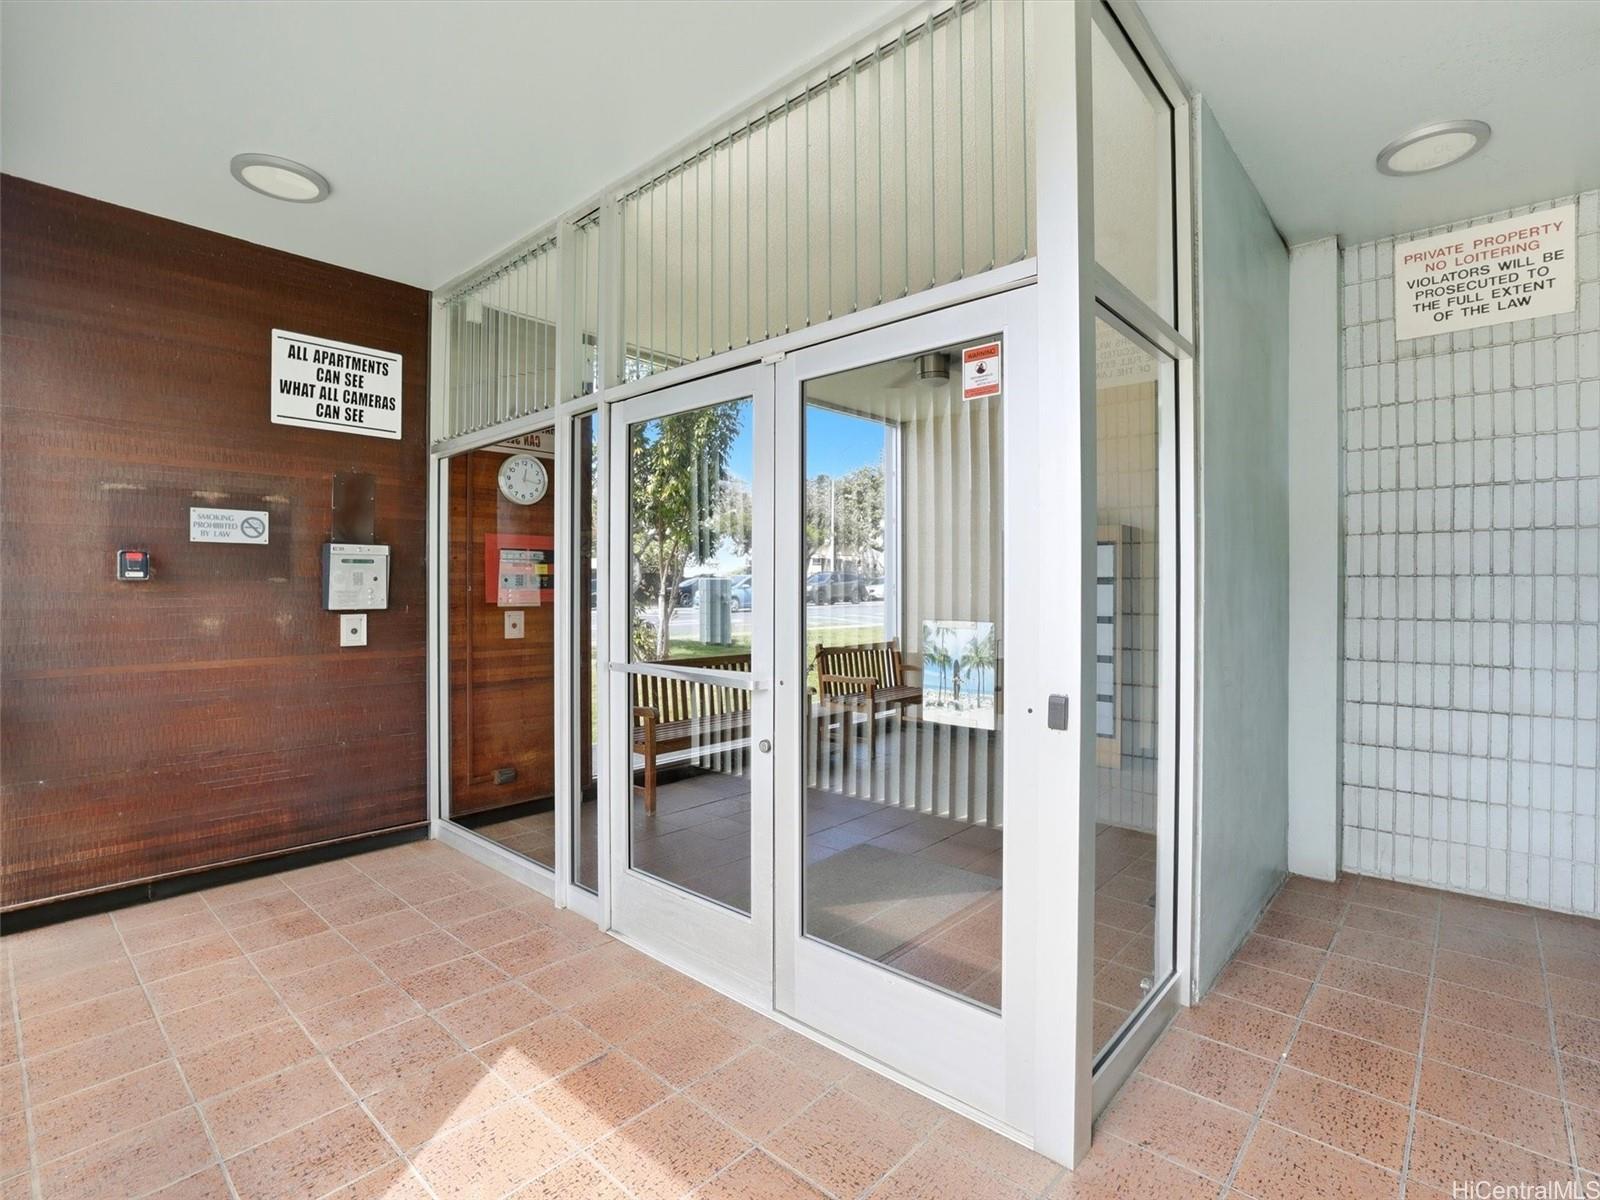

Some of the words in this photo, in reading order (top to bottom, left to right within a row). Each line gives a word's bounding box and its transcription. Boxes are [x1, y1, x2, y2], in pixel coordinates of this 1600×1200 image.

[1404, 243, 1464, 265] PRIVATE
[1473, 221, 1563, 250] PROPERTY
[1425, 260, 1447, 273] NO
[1455, 239, 1540, 267] LOITERING
[1406, 264, 1490, 290] VIOLATORS
[1497, 256, 1535, 272] WILL
[1542, 249, 1565, 263] BE
[1415, 272, 1519, 301] PROSECUTED
[1527, 265, 1550, 279] TO
[1412, 299, 1441, 313] THE
[1447, 292, 1484, 307] FULL
[1491, 277, 1557, 299] EXTENT
[1433, 309, 1454, 322] OF
[1461, 303, 1490, 318] THE
[1498, 295, 1532, 311] LAW
[287, 344, 309, 362] ALL
[312, 349, 389, 377] APARTMENTS
[279, 378, 316, 398] WHAT
[319, 386, 339, 402] ALL
[342, 389, 396, 411] CAMERAS
[316, 367, 340, 385] CAN
[344, 372, 364, 389] SEE
[316, 402, 340, 420] CAN
[344, 407, 364, 423] SEE
[193, 520, 238, 530] PROHIBITED
[197, 512, 235, 522] SMOKING
[200, 529, 209, 537] BY
[213, 530, 231, 538] LAW
